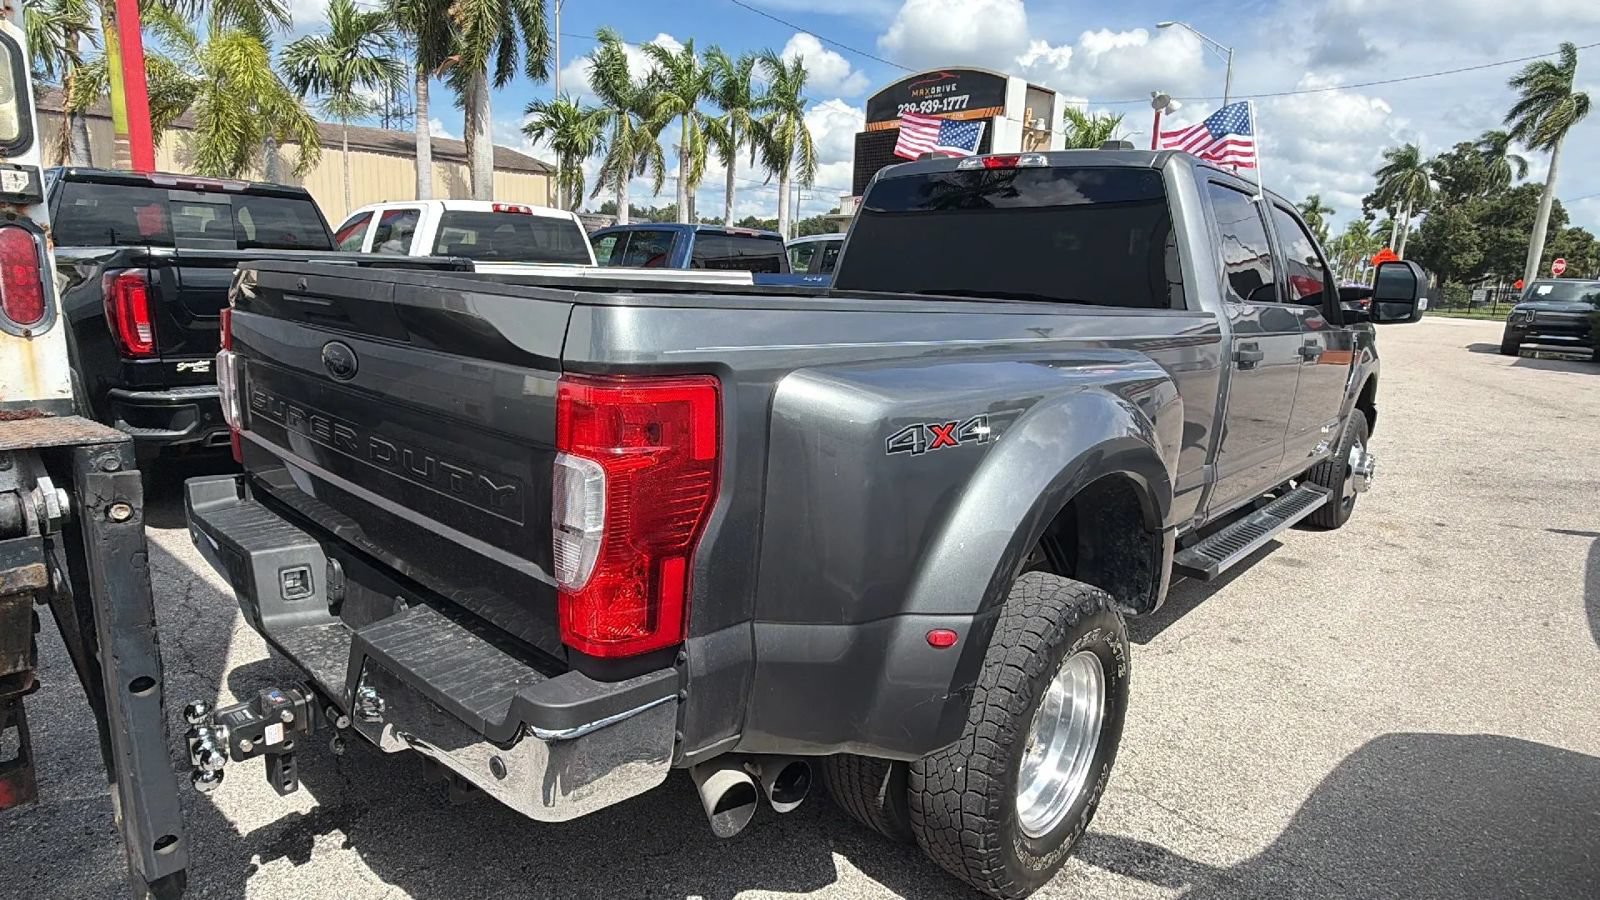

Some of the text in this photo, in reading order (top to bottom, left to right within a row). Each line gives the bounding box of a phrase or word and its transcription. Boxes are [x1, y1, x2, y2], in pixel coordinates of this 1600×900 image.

[896, 95, 969, 117] 239-939-1777
[250, 389, 516, 507] SUPER DUTY
[885, 413, 991, 456] 4X4
